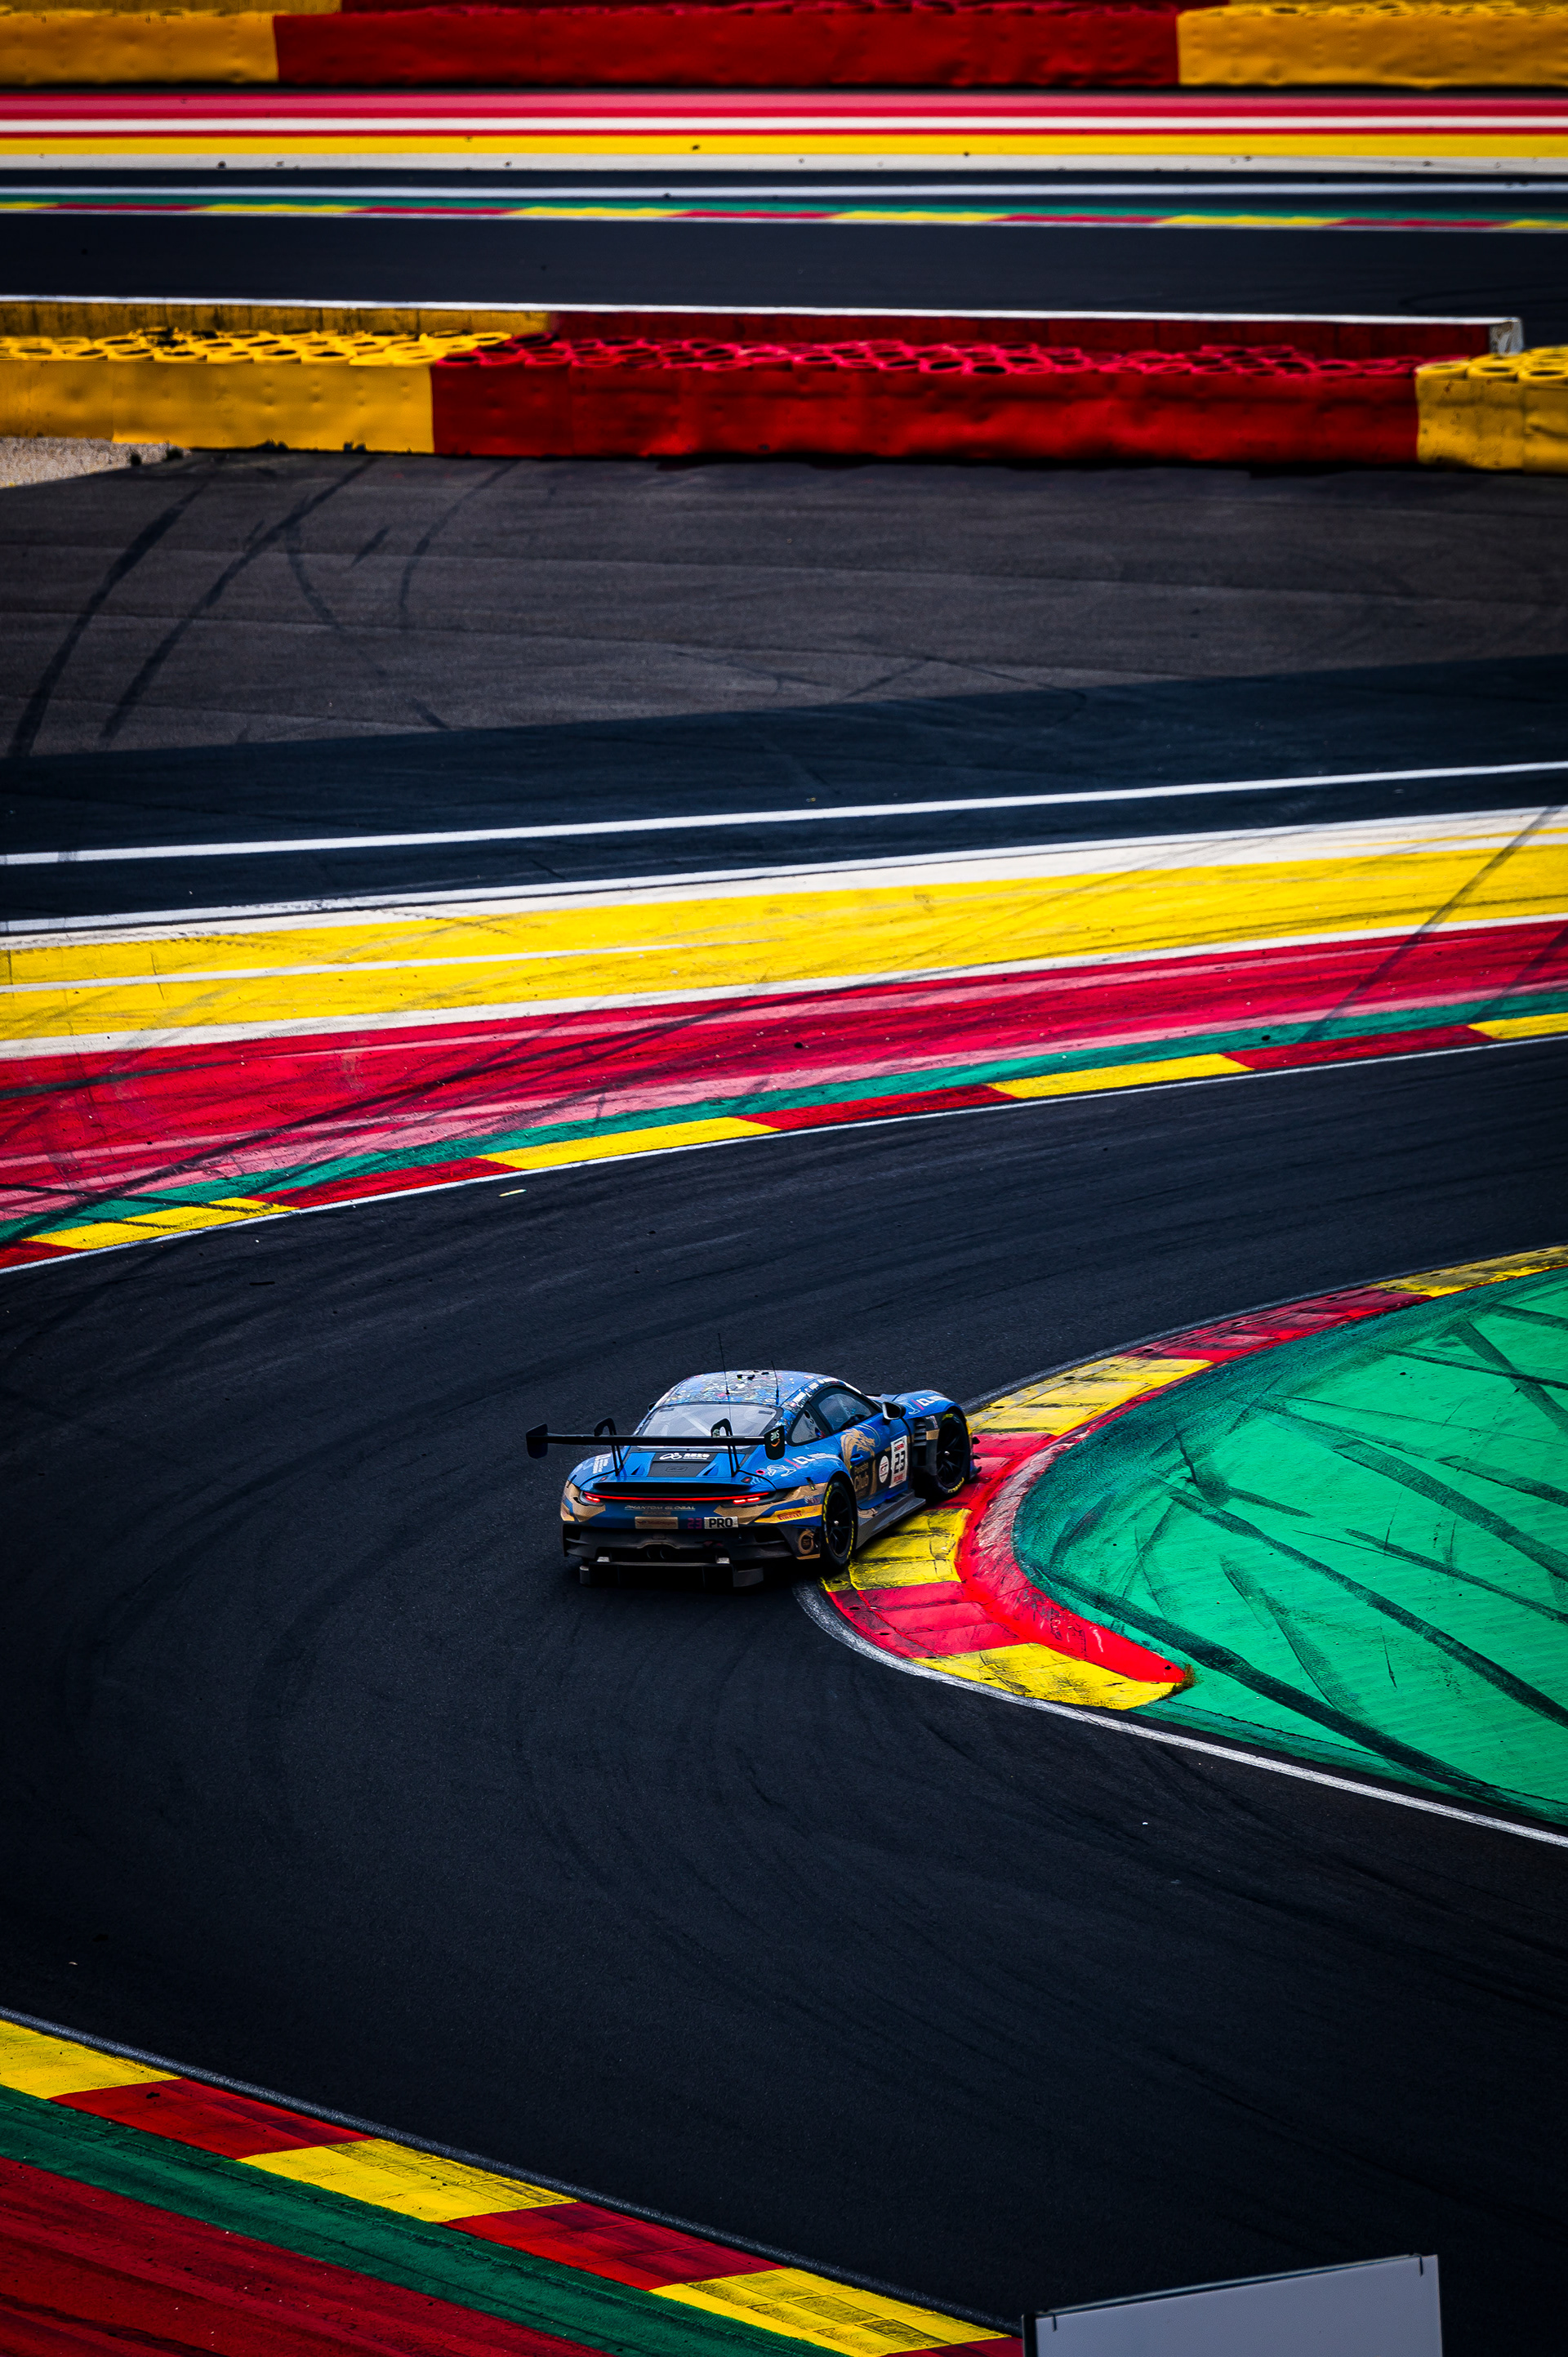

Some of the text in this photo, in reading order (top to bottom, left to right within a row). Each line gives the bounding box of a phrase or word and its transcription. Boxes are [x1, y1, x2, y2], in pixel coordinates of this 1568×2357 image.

[893, 1450, 906, 1474] 23
[854, 1472, 868, 1492] Club
[687, 1517, 702, 1529] 23
[708, 1517, 733, 1528] PRO
